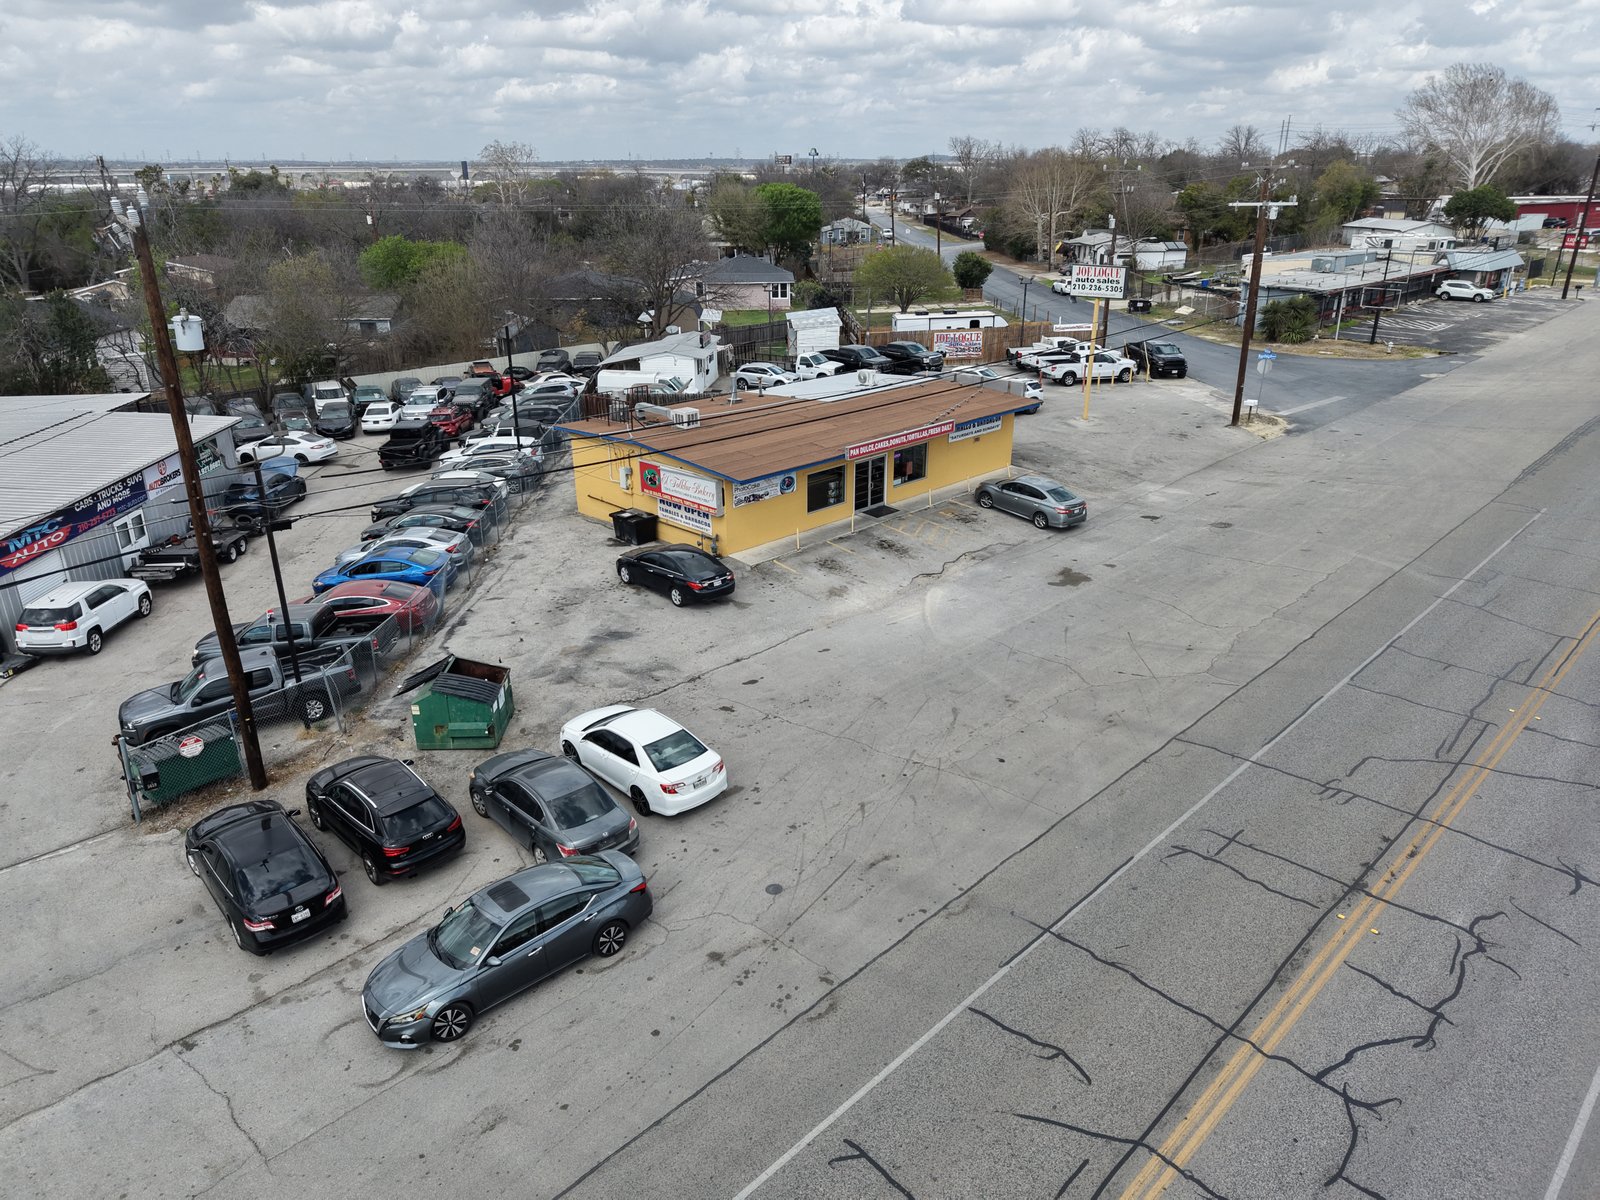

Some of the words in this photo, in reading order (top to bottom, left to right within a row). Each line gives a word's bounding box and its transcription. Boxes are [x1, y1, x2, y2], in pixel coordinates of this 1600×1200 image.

[1076, 266, 1092, 277] JOE
[1093, 266, 1121, 278] LOGUE
[1072, 284, 1123, 293] 210-236-5305
[935, 334, 950, 344] JOE
[952, 333, 981, 342] LOGUE
[849, 448, 860, 457] PAN
[941, 423, 953, 432] DAILY
[148, 469, 181, 491] AUTOBROKERS
[74, 496, 94, 512] CARS
[96, 482, 124, 501] TRUCKS
[127, 472, 143, 487] SUVS
[97, 499, 112, 512] AND
[112, 488, 131, 505] MORE
[659, 506, 679, 517] TAMALES
[684, 515, 711, 528] BARBACOA
[8, 518, 61, 553] MTC
[12, 531, 64, 564] AUTO
